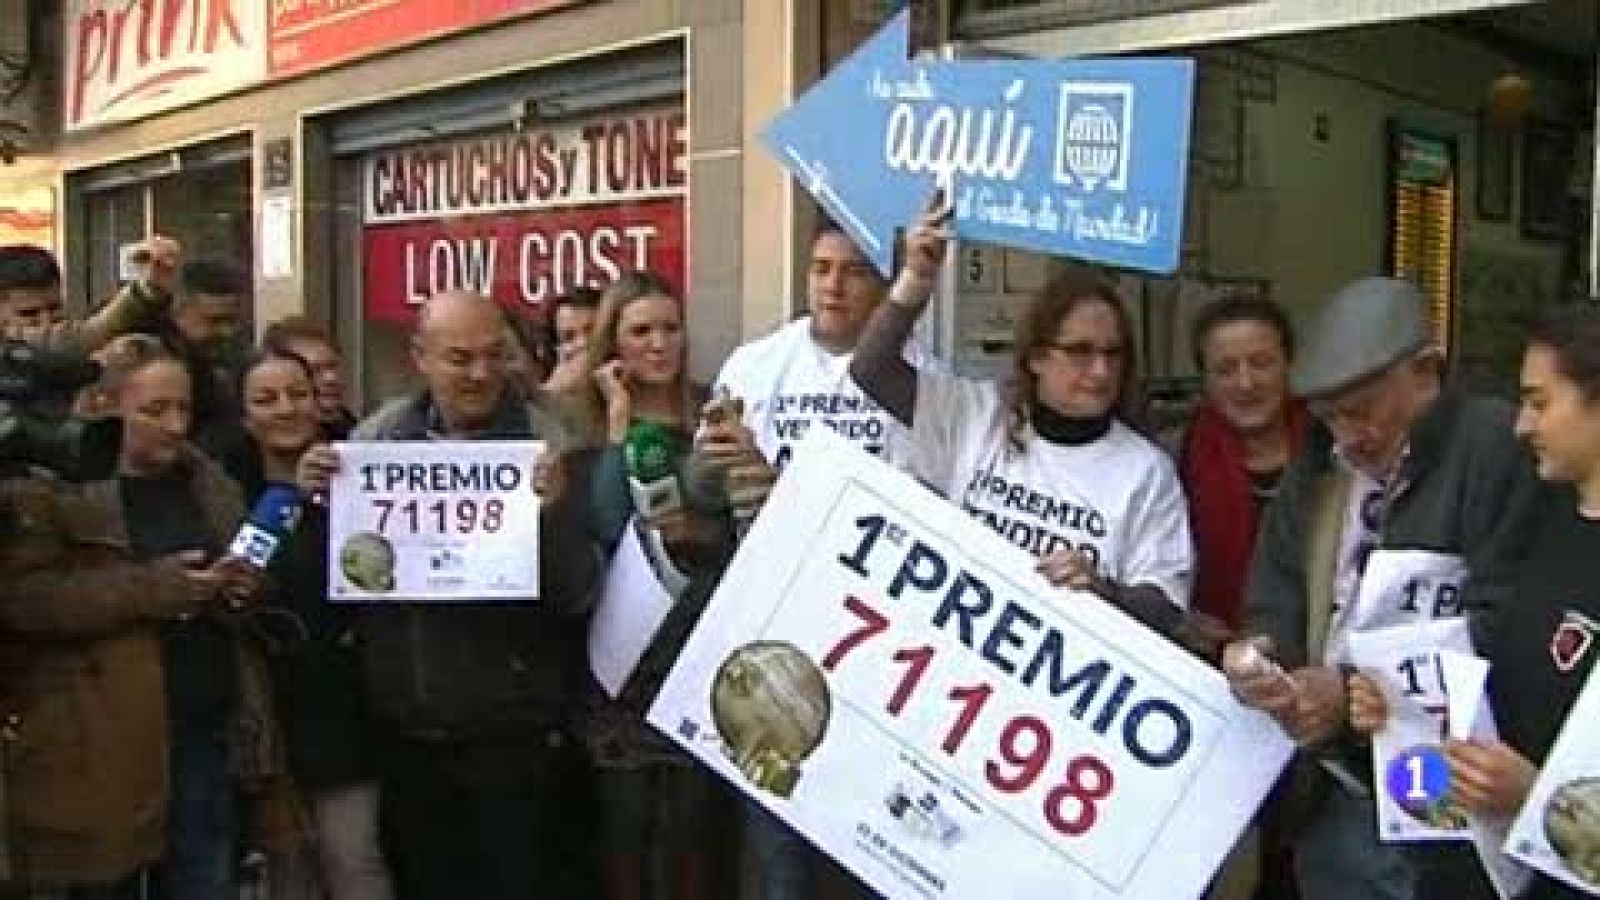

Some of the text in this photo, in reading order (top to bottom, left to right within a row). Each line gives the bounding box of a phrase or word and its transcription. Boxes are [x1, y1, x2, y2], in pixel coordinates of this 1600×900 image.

[887, 79, 1033, 208] aquí
[406, 226, 657, 304] LOW COST
[372, 499, 504, 534] 71198
[386, 462, 522, 492] PREMIO
[886, 540, 1194, 769] PREMIO
[821, 595, 1115, 838] 71198
